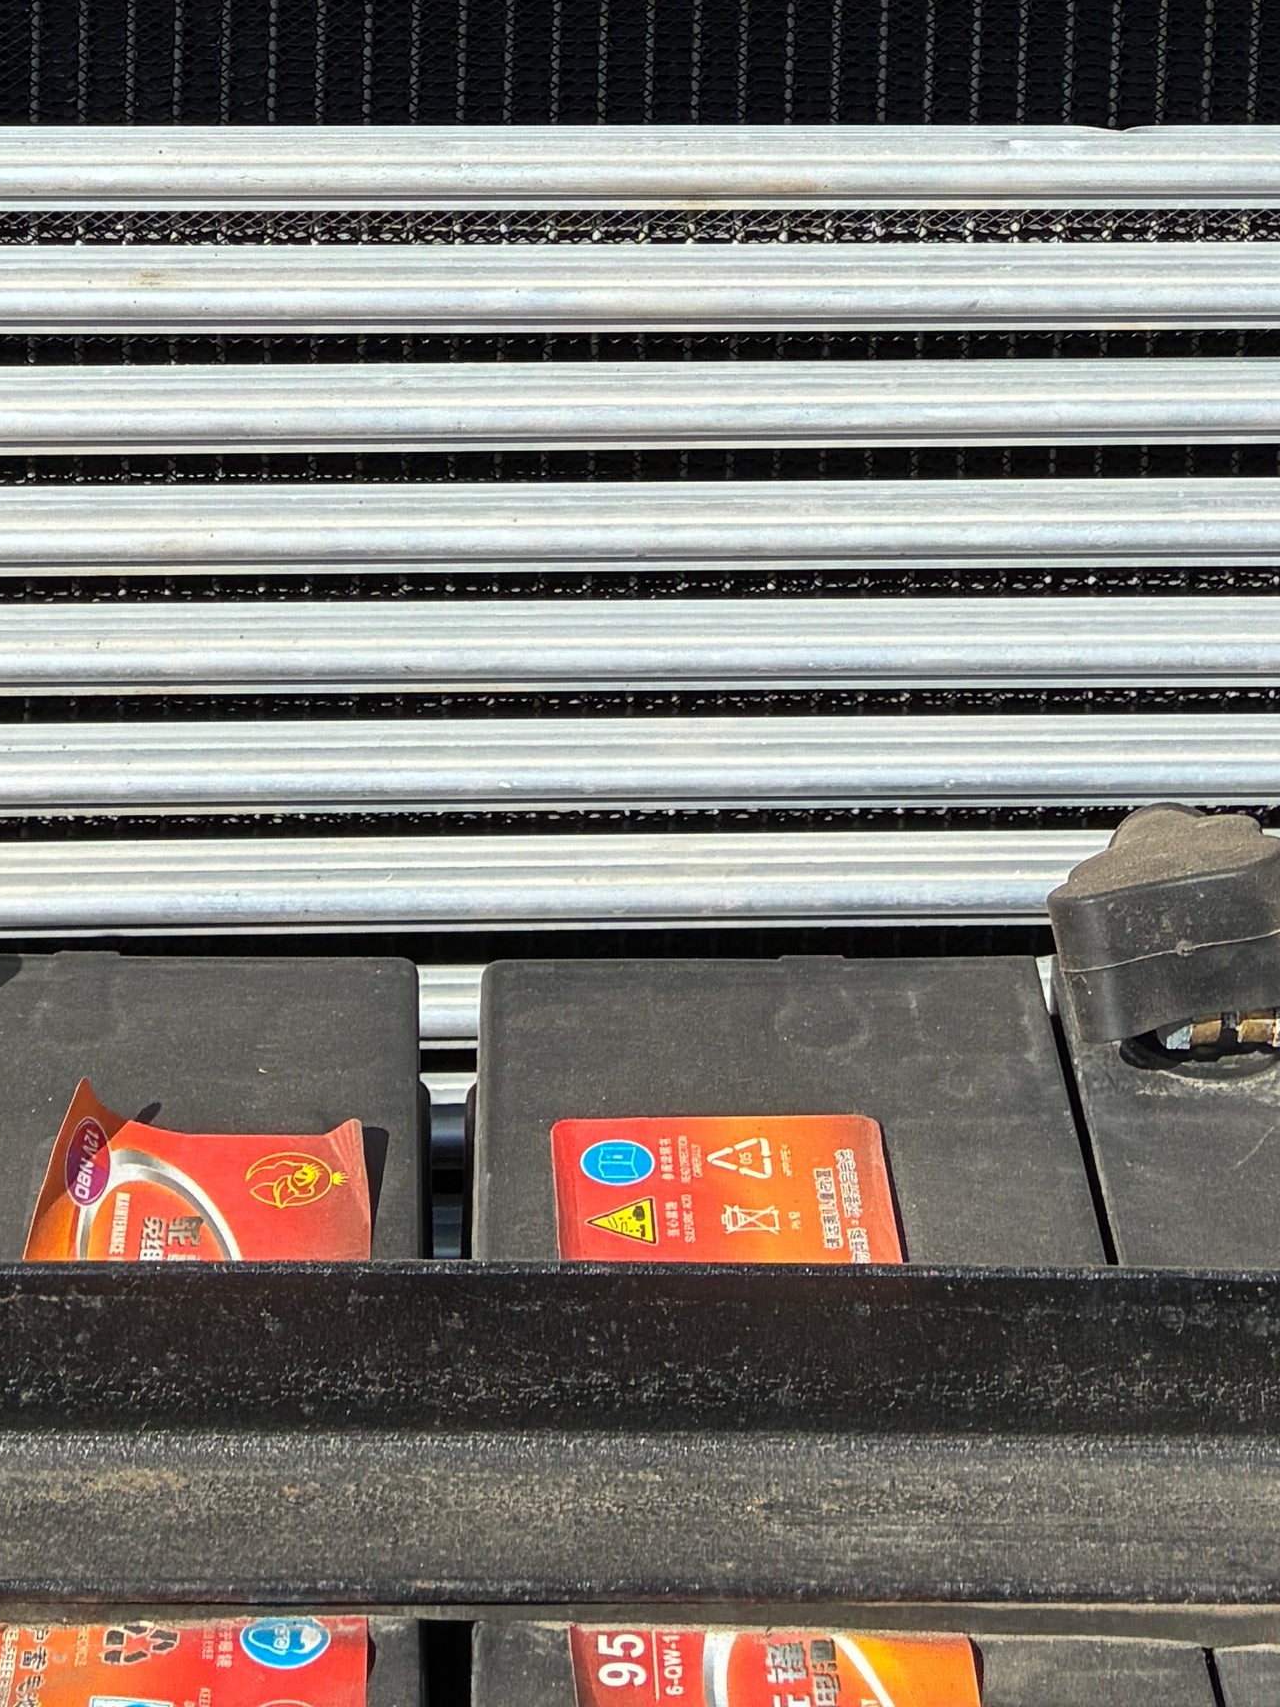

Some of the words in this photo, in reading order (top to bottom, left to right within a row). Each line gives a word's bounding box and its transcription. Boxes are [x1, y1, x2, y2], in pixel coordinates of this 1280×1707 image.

[74, 1157, 94, 1200] N80
[598, 1633, 646, 1687] 95
[662, 1633, 685, 1696] 6-QW-1
